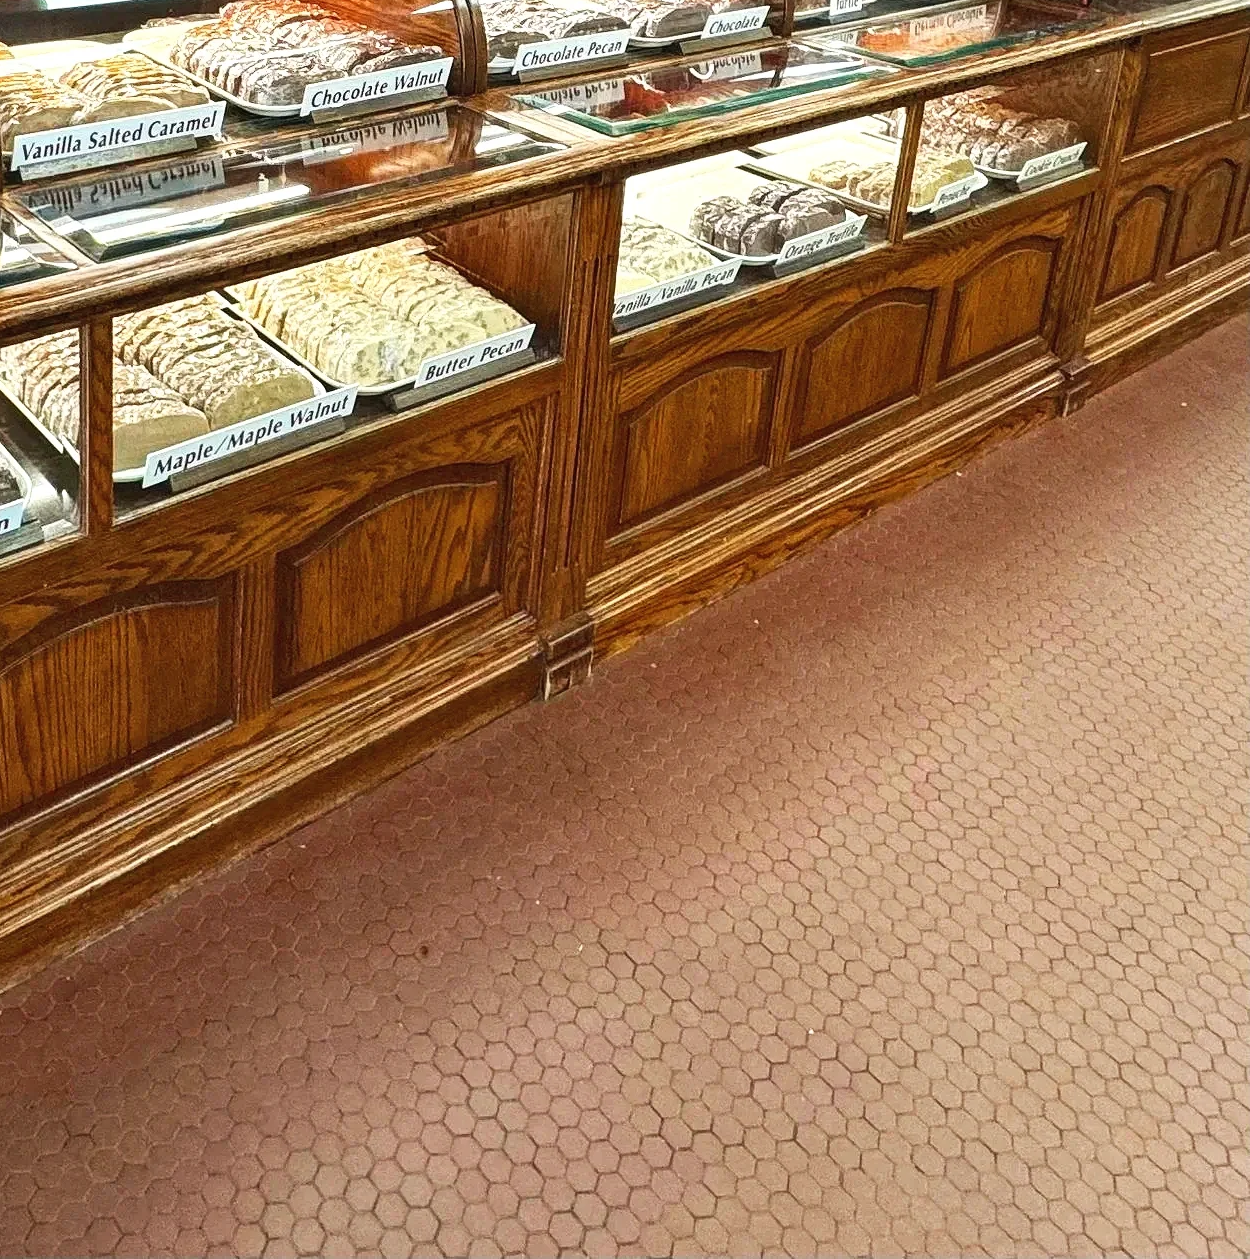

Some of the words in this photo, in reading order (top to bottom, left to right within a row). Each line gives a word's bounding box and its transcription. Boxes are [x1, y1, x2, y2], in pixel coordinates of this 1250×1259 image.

[709, 15, 759, 35] Chocolate
[521, 44, 584, 67] Chocolate
[588, 40, 622, 56] Pecan
[311, 81, 388, 107] Chocolate
[394, 68, 444, 90] Walnut
[22, 135, 81, 161] Vanilla
[88, 123, 144, 149] Salted
[148, 110, 218, 138] Caramel
[785, 237, 823, 259] Orange
[826, 224, 859, 246] Truffle
[702, 267, 734, 286] Pecan
[424, 354, 476, 381] Butter
[481, 336, 523, 363] Pecan
[154, 421, 283, 477] Maple/Maple
[290, 395, 349, 431] Walnut
